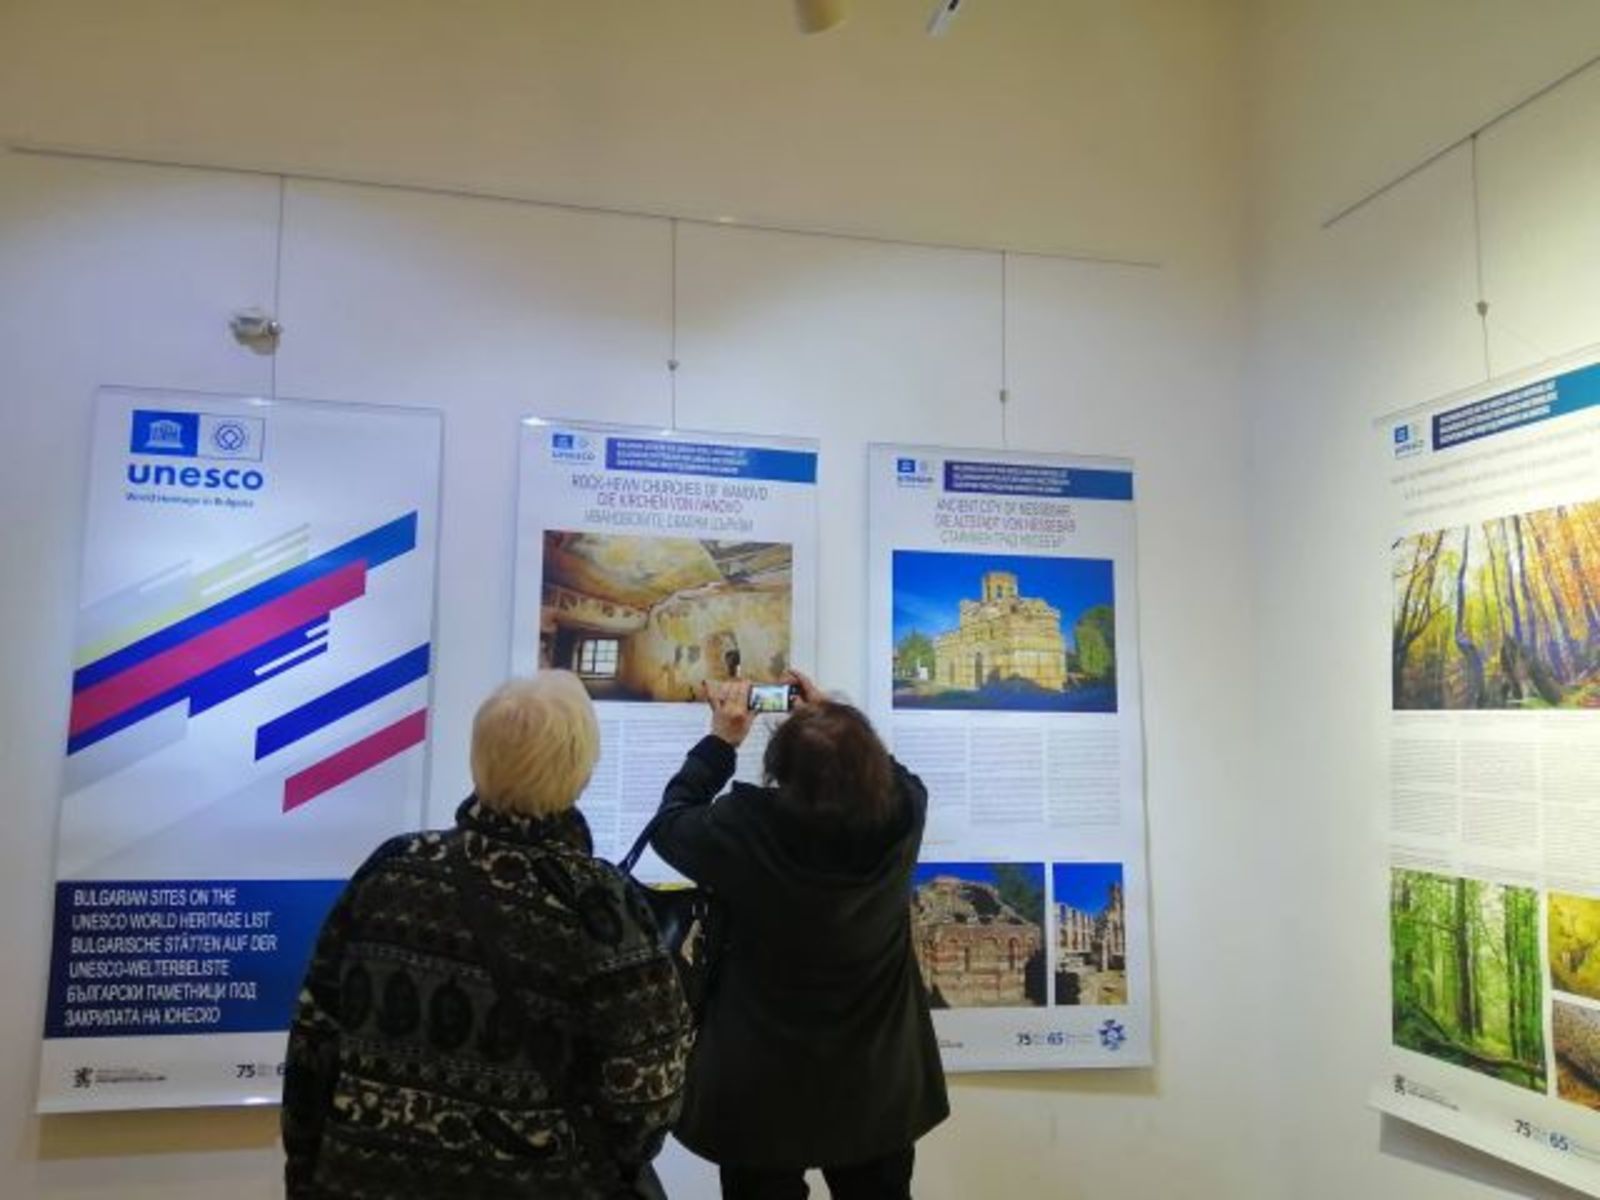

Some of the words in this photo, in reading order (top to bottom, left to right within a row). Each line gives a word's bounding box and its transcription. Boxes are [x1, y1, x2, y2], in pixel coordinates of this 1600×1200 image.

[127, 463, 264, 491] unesco
[73, 888, 149, 907] BULGARIAN
[150, 888, 187, 906] SITES
[189, 888, 210, 906] ON
[211, 887, 237, 906] THE
[72, 912, 128, 931] UNESCO
[129, 912, 178, 930] WORLD
[179, 911, 243, 929] HERITAGE
[244, 911, 272, 929] LIST
[71, 934, 162, 954] BULGARISCHE
[163, 930, 221, 952] STÄTTEN
[222, 934, 250, 951] AUF
[251, 933, 278, 951] DER
[66, 983, 144, 1004] БЪЛГАРСКИ
[146, 982, 227, 1003] ПАМЕТНИЦИ
[228, 981, 257, 1001] ПОД
[64, 1008, 141, 1027] ЗАКРИЛАТА
[142, 1008, 162, 1026] НА
[163, 1006, 221, 1025] ЮНЕСКО
[1016, 1032, 1032, 1047] 75
[236, 1063, 256, 1079] 75
[1513, 1118, 1532, 1139] 75
[1549, 1131, 1569, 1152] 65
